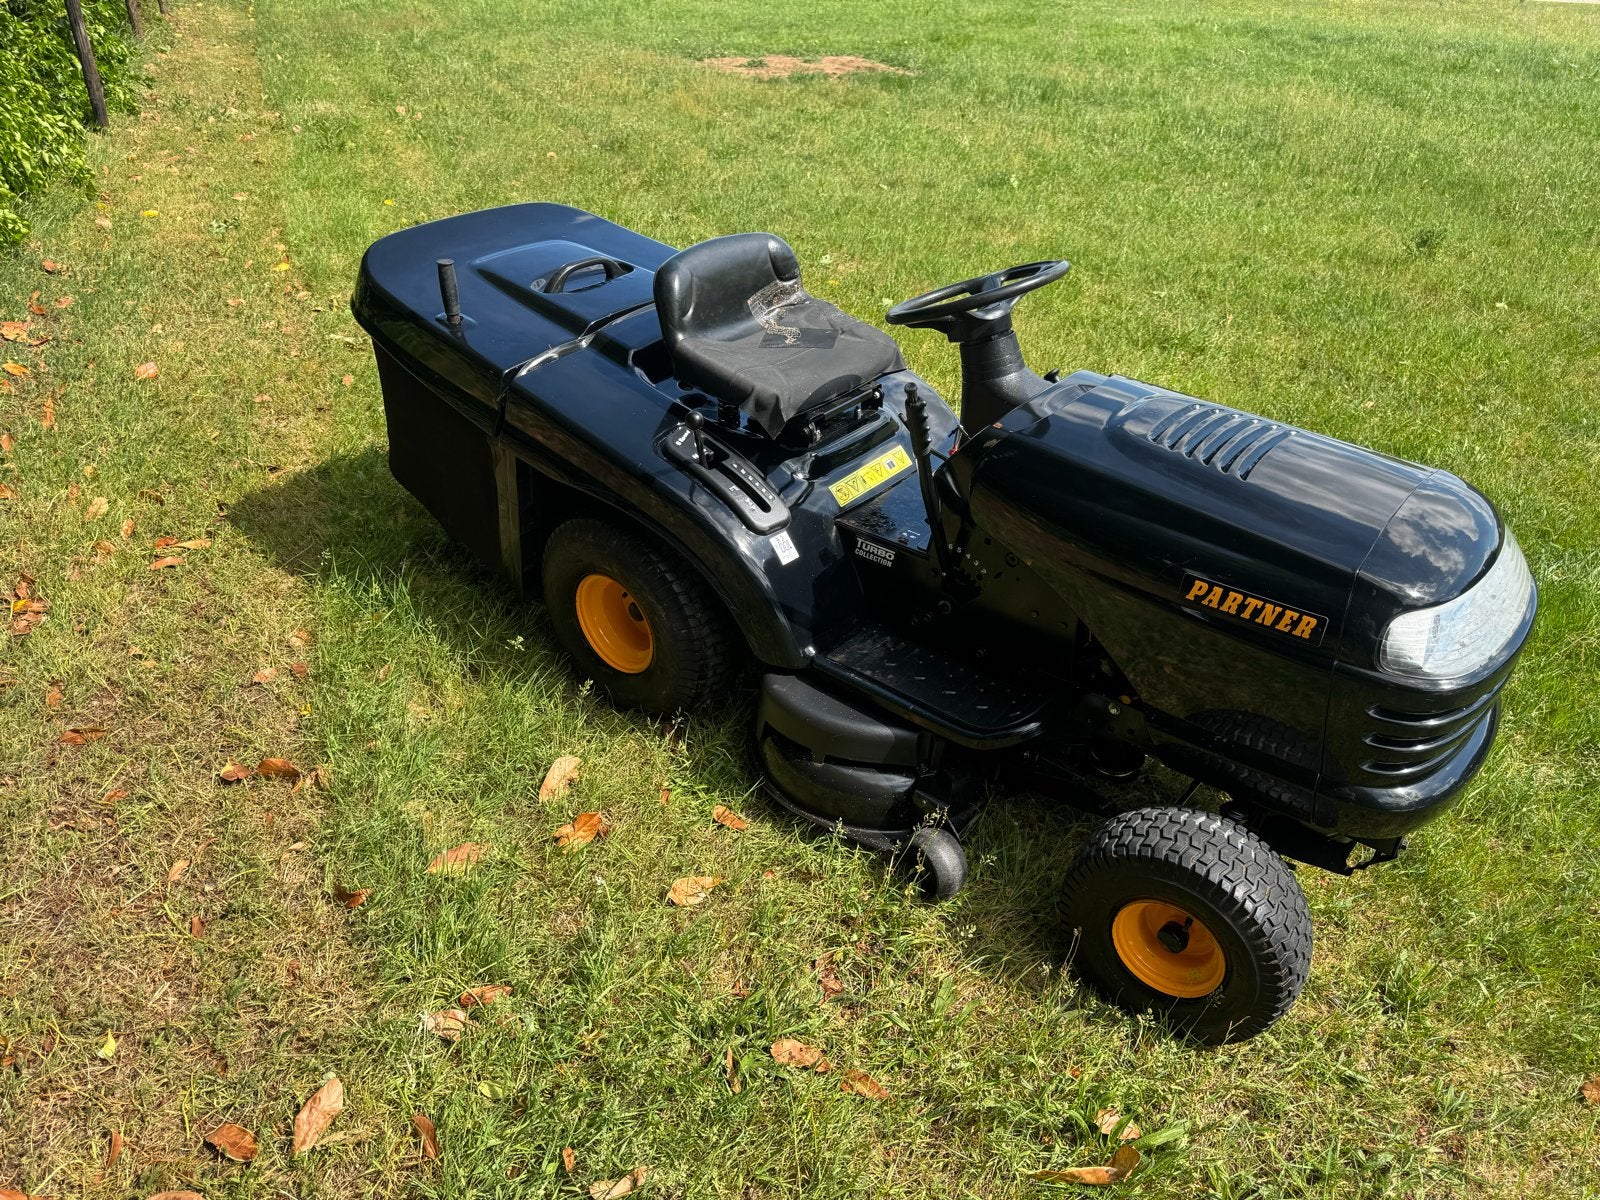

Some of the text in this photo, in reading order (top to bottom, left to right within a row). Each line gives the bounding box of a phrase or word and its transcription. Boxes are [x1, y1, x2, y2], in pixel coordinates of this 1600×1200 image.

[854, 548, 893, 568] COLLECTION
[856, 537, 896, 561] TURBO
[1185, 580, 1318, 640] PARTNER
